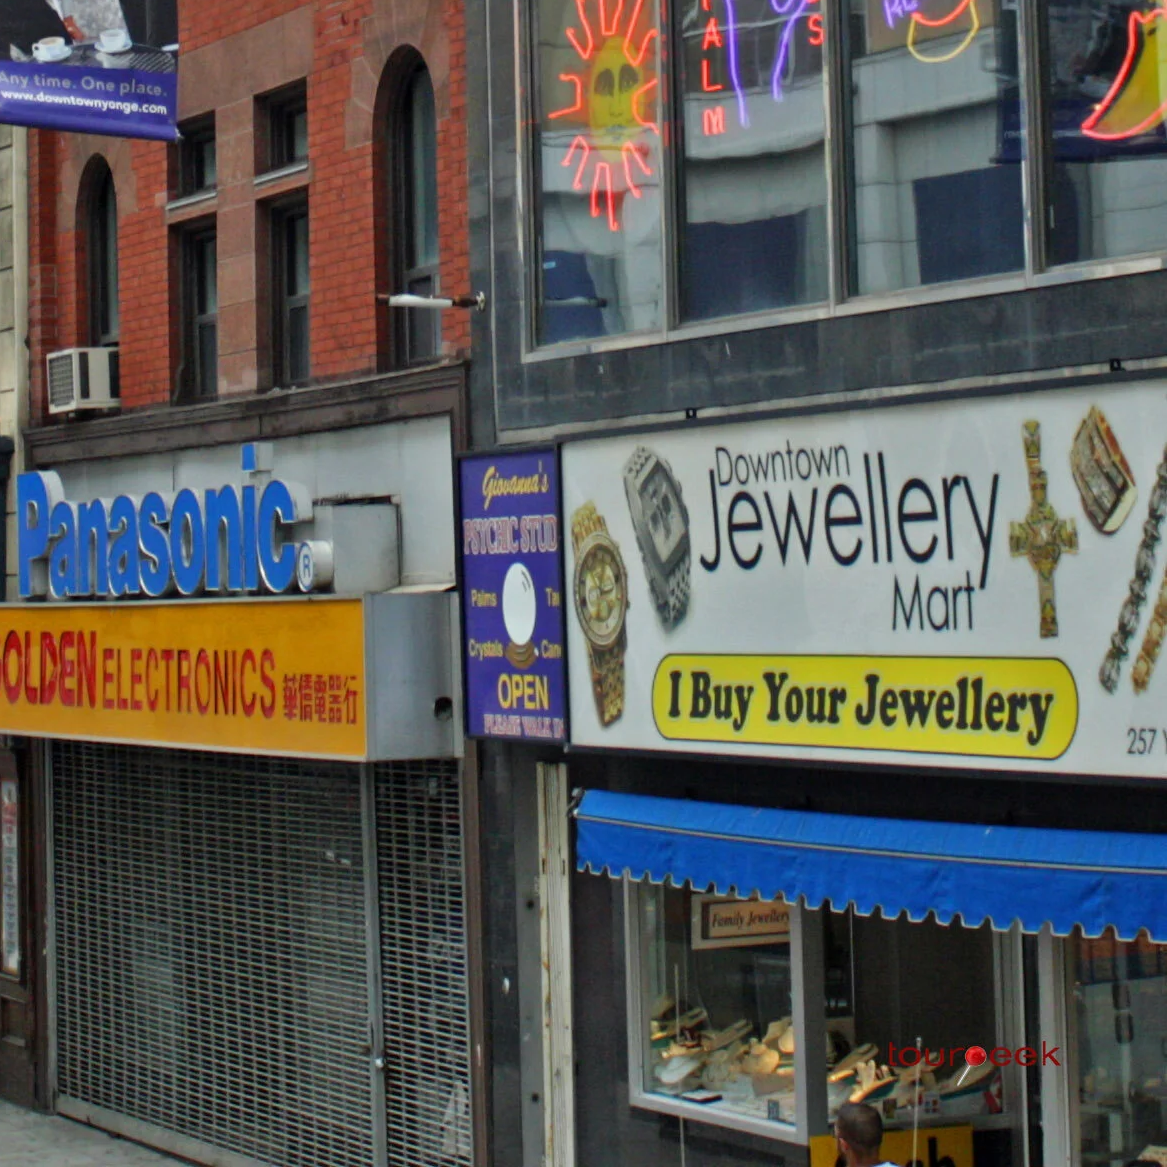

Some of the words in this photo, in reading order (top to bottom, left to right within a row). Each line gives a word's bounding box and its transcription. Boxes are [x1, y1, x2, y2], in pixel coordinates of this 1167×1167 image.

[1, 90, 168, 115] www.downtownyonge.com
[34, 73, 77, 89] time.
[81, 76, 116, 92] One
[120, 78, 168, 100] place.
[714, 443, 851, 488] Downtown
[18, 442, 300, 599] Panasonic
[463, 516, 519, 556] PSYCHIC
[700, 450, 1000, 591] Jewellery
[471, 589, 498, 608] Palms
[892, 574, 975, 632] Mart
[468, 638, 504, 662] Crystals
[102, 647, 277, 719] ELECTRONICS
[497, 673, 550, 711] OPEN
[669, 670, 682, 720] I
[689, 672, 754, 733] Buy
[763, 672, 847, 727] Your
[855, 674, 1055, 746] Jewellery
[1127, 727, 1157, 755] 257
[711, 910, 744, 931] Family
